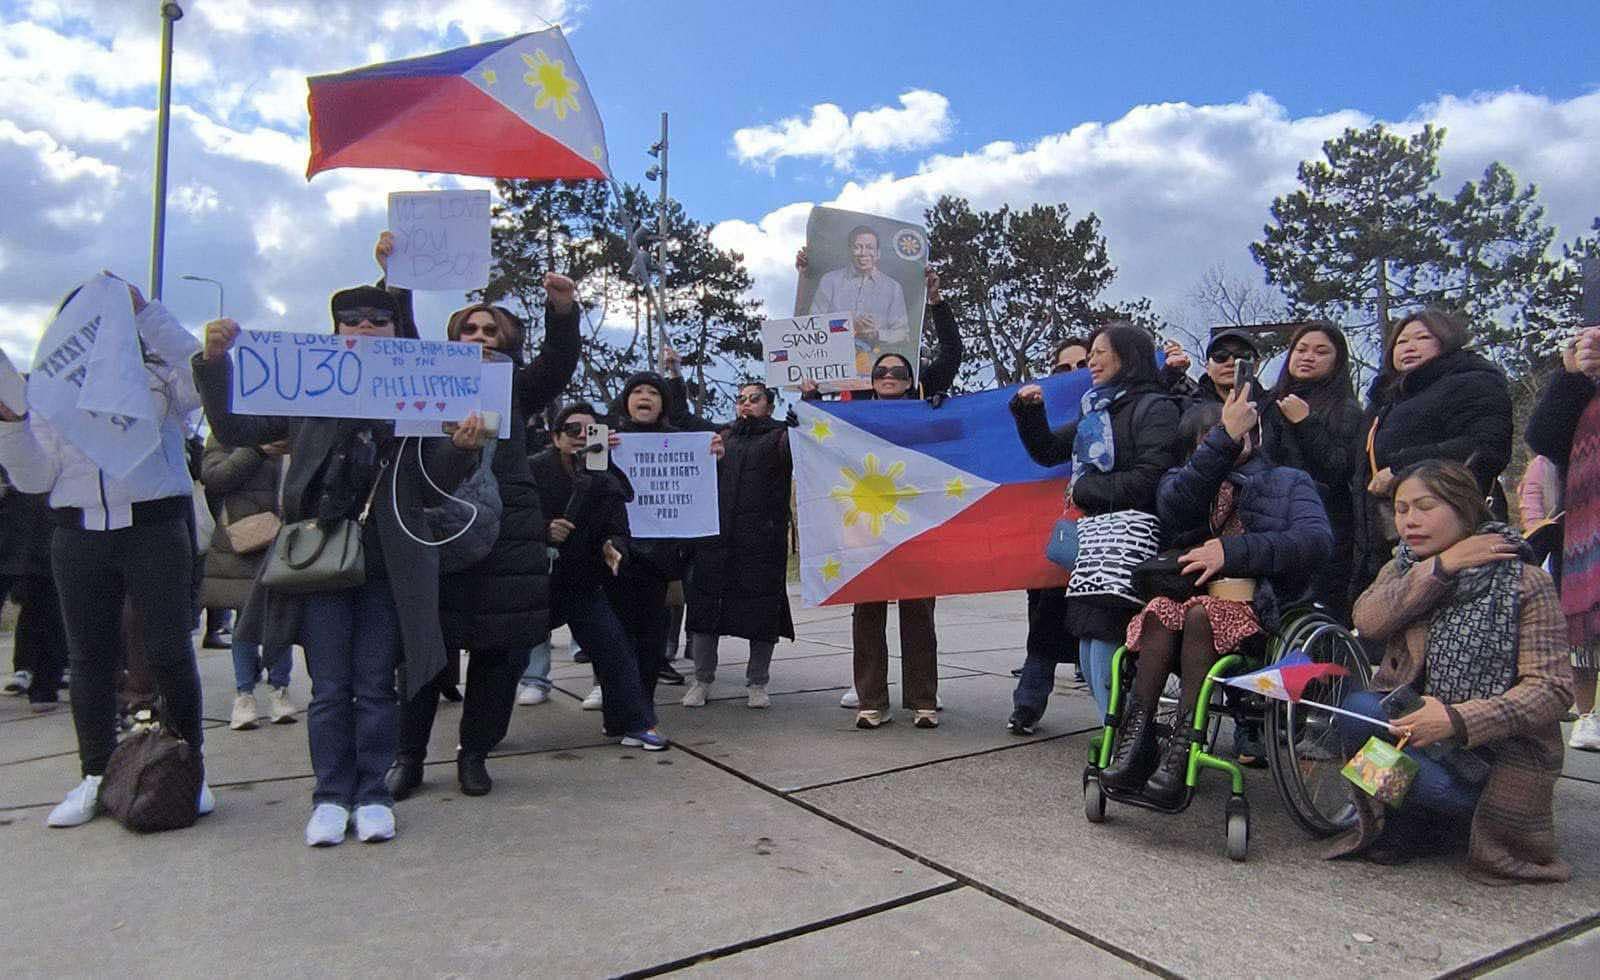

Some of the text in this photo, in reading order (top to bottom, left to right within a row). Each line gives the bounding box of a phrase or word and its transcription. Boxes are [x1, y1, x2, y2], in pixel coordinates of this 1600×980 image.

[792, 316, 821, 331] WE
[249, 332, 339, 346] WE LOVE
[782, 331, 828, 348] STAND
[372, 339, 415, 355] SEND
[420, 342, 444, 356] HIM
[39, 334, 87, 378] TATAY
[392, 357, 435, 366] TO THE
[799, 349, 828, 361] with
[238, 346, 362, 400] DU30
[372, 375, 480, 398] PHILIPPINES
[634, 451, 695, 463] YOUR CONCERN
[630, 466, 700, 477] IS HUMAN RIGHTS
[672, 480, 680, 491] IS
[638, 494, 693, 505] HUMAN LIVES!
